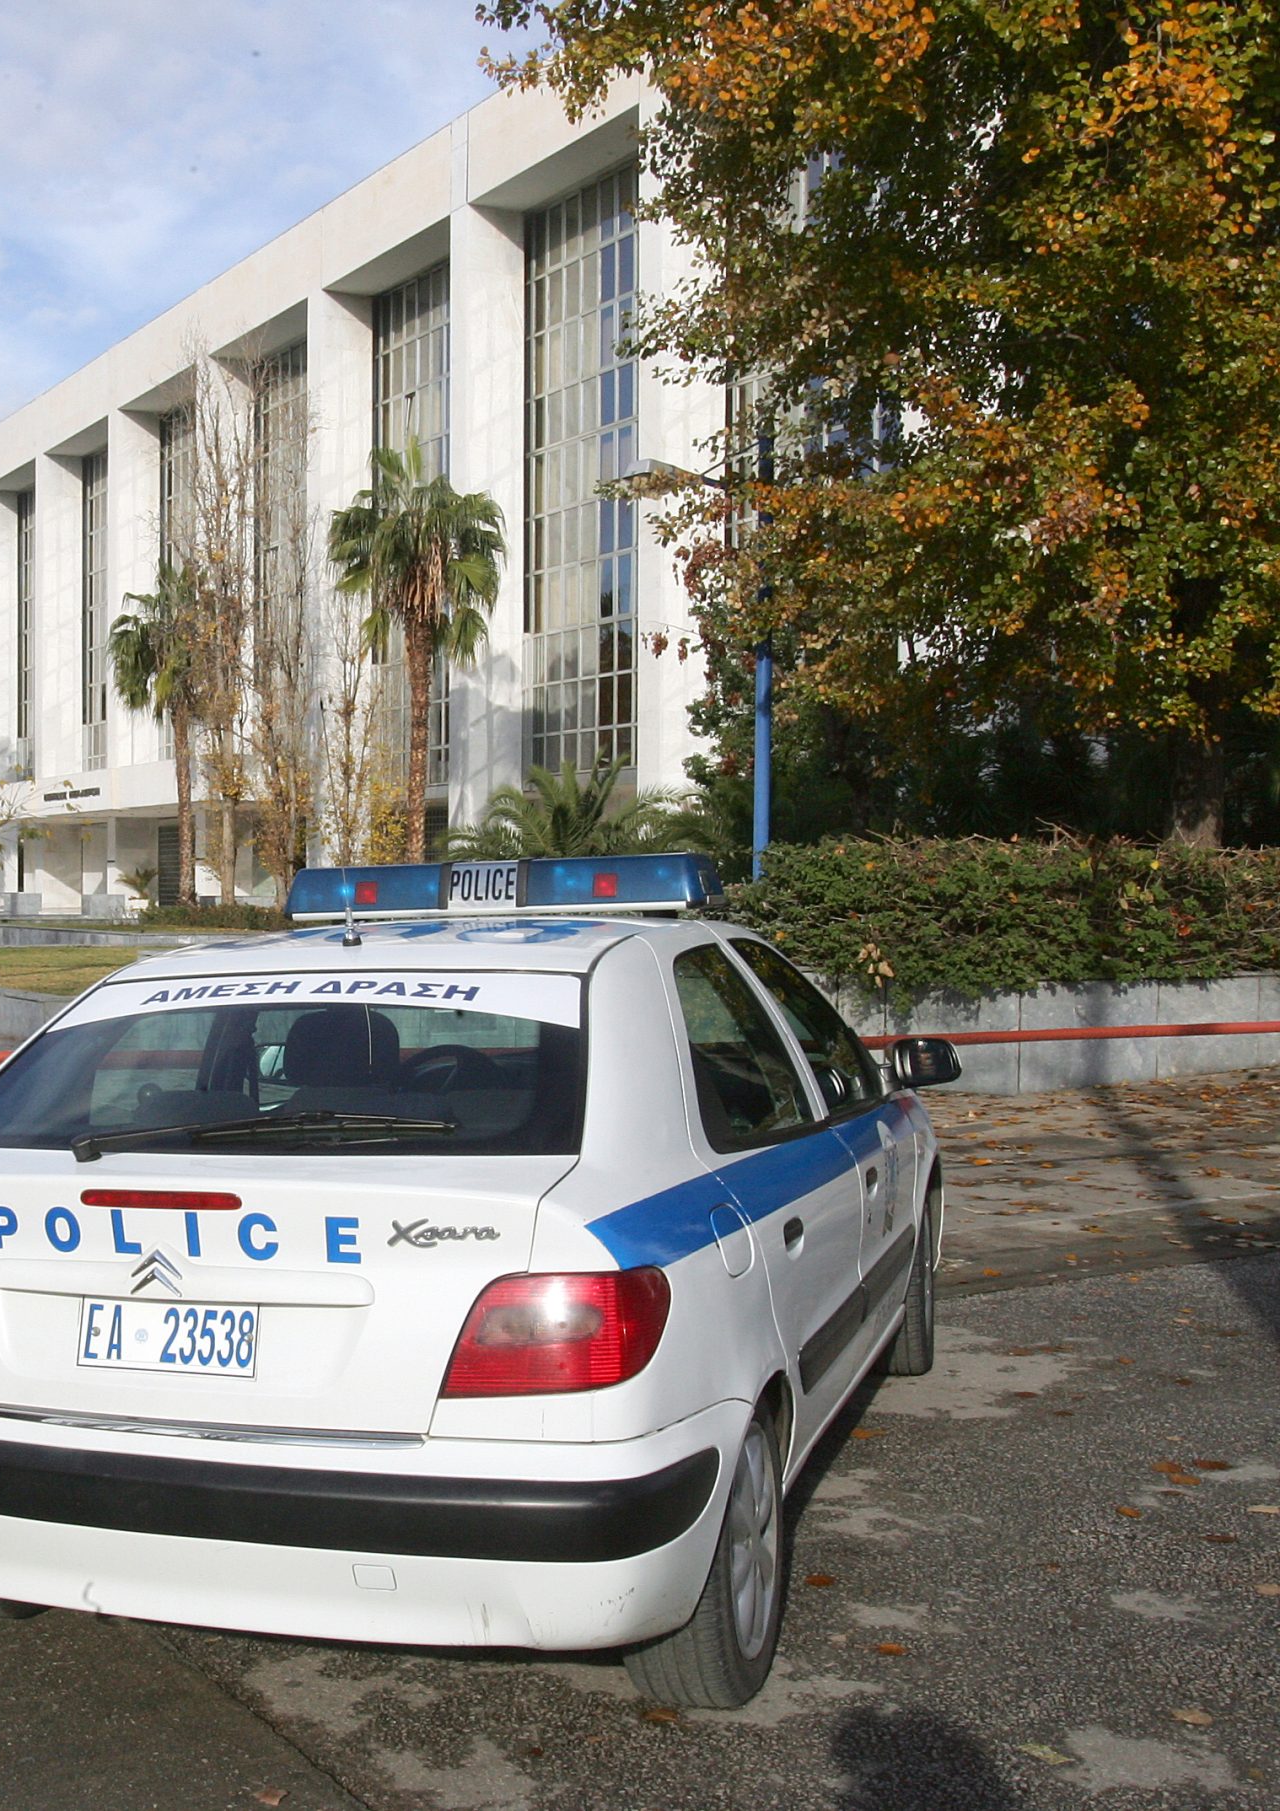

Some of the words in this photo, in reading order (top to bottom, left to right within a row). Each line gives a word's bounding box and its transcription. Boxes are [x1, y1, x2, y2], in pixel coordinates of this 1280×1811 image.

[449, 867, 516, 901] POLICE
[139, 980, 303, 1005] ΑΜΕΣΗ
[310, 980, 481, 1002] ΔΡΑΣΗ
[386, 1217, 501, 1249] Xsara
[83, 1303, 122, 1360] EA
[159, 1306, 255, 1369] 23538
